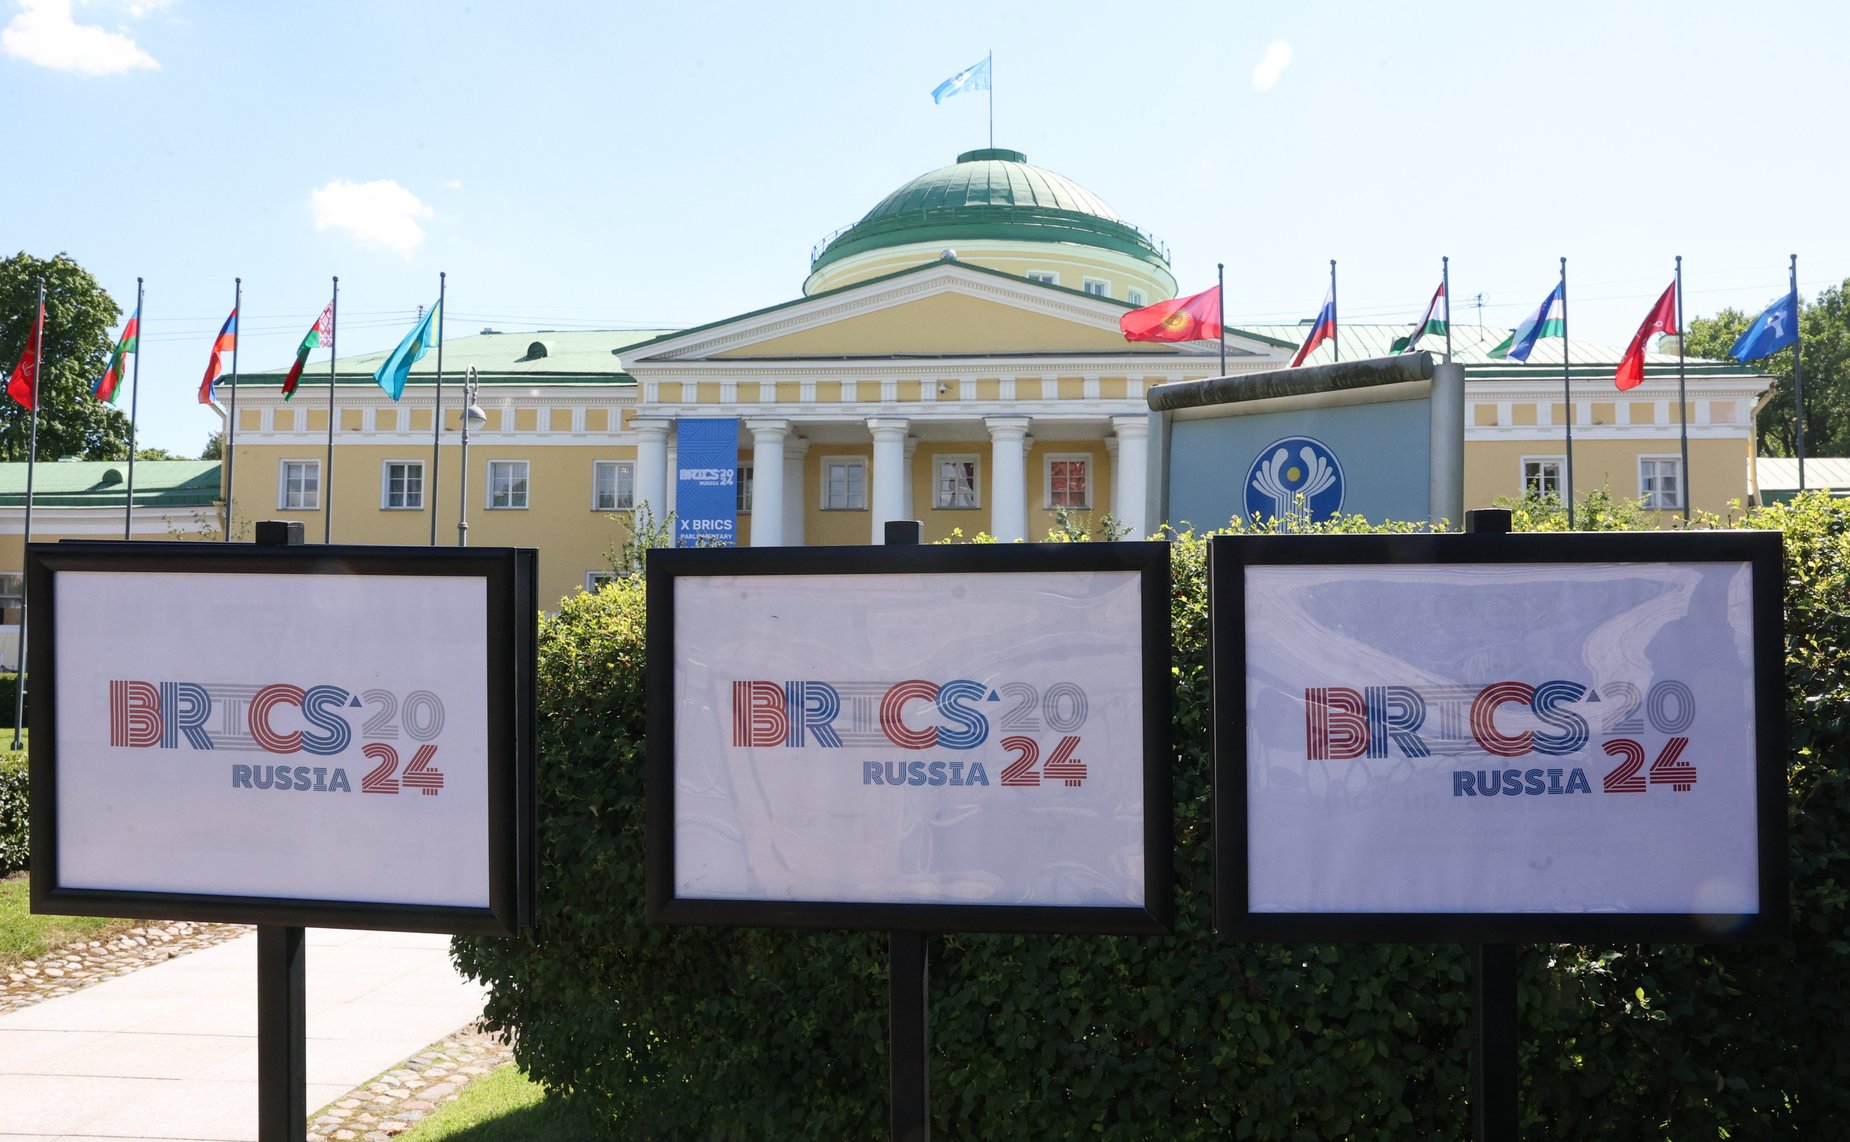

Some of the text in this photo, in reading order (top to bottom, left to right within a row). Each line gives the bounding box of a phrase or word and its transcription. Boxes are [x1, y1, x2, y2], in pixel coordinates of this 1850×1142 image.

[680, 469, 734, 480] BRICS 20
[720, 477, 733, 486] 24
[681, 519, 733, 530] X BRICS
[110, 680, 446, 756] BRICS 20
[733, 679, 1089, 750] BRICS 20
[1305, 679, 1696, 760] BRICS 20
[232, 742, 445, 796] RUSSIA 24
[863, 735, 1088, 787] RUSSIA 24
[1453, 737, 1697, 797] RUSSIA 24
